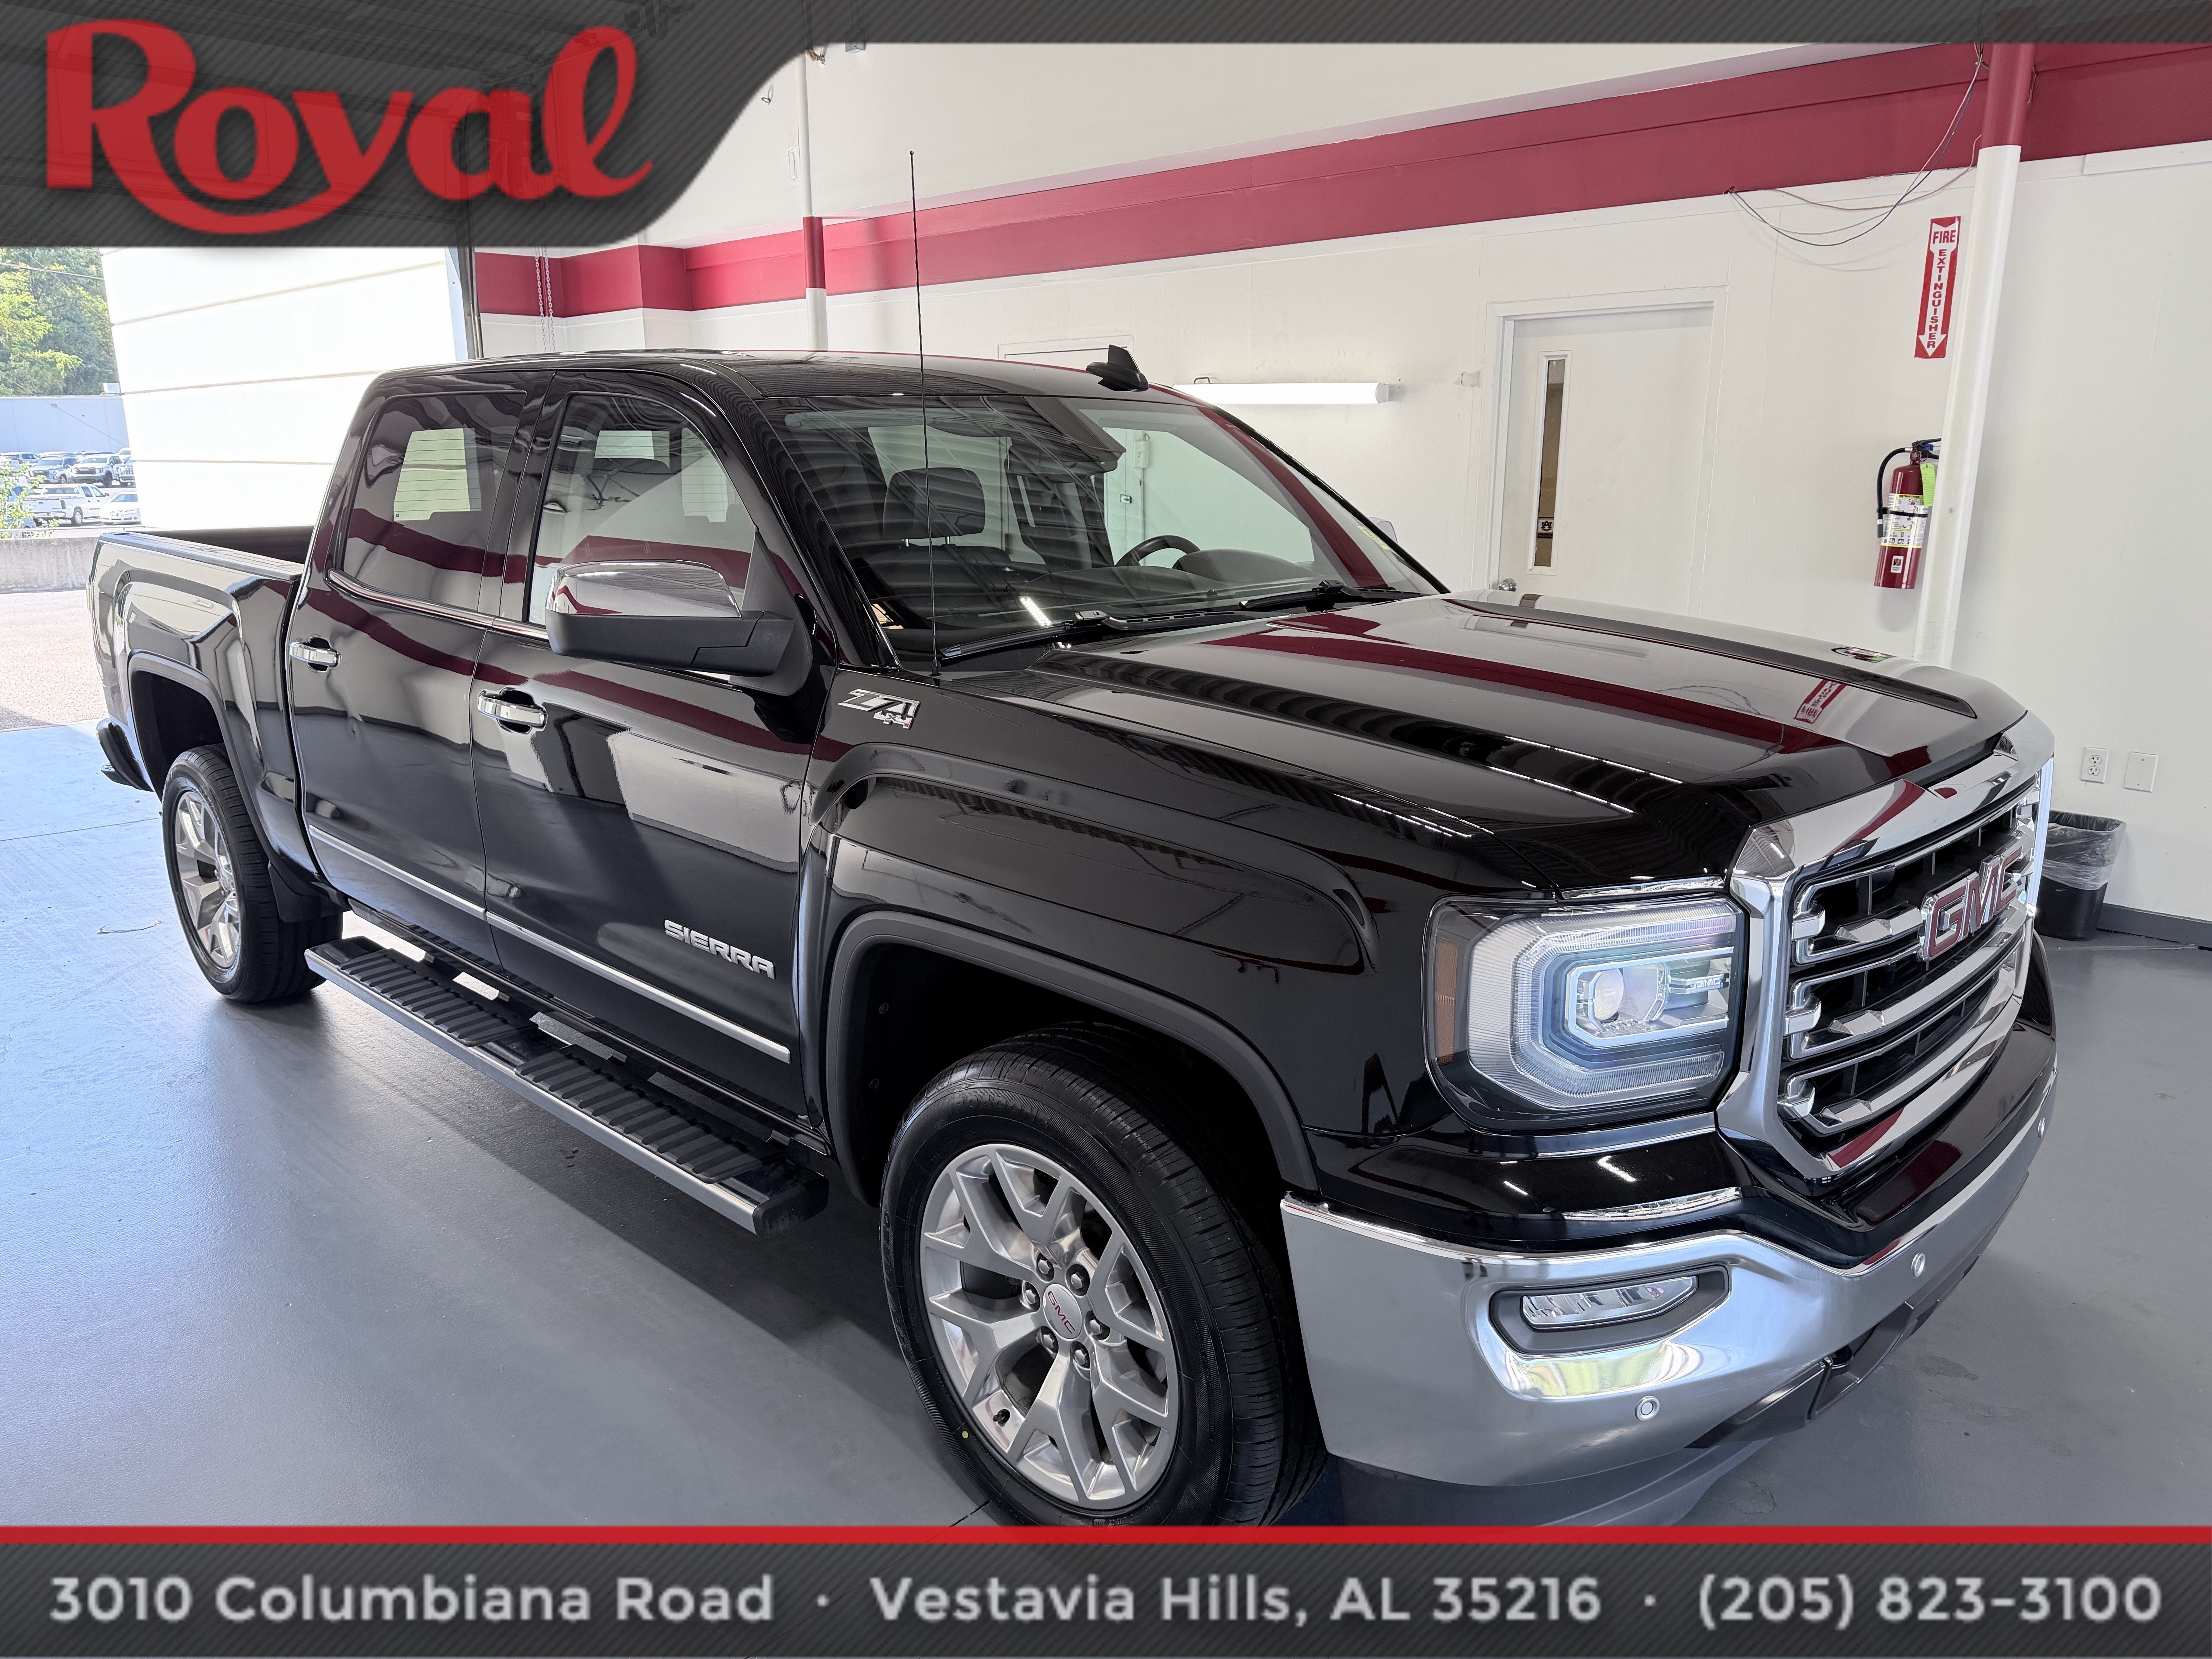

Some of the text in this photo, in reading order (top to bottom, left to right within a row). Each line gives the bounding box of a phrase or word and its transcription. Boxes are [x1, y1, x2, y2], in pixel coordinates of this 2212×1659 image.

[1932, 230, 1956, 244] FIRE
[1927, 249, 1947, 348] EXTINGUISHER
[837, 689, 919, 717] Z71
[1923, 845, 2024, 961] GMC
[664, 919, 775, 980] SIERRA
[1696, 977, 1721, 988] GMC
[1048, 1290, 1075, 1334] GMC
